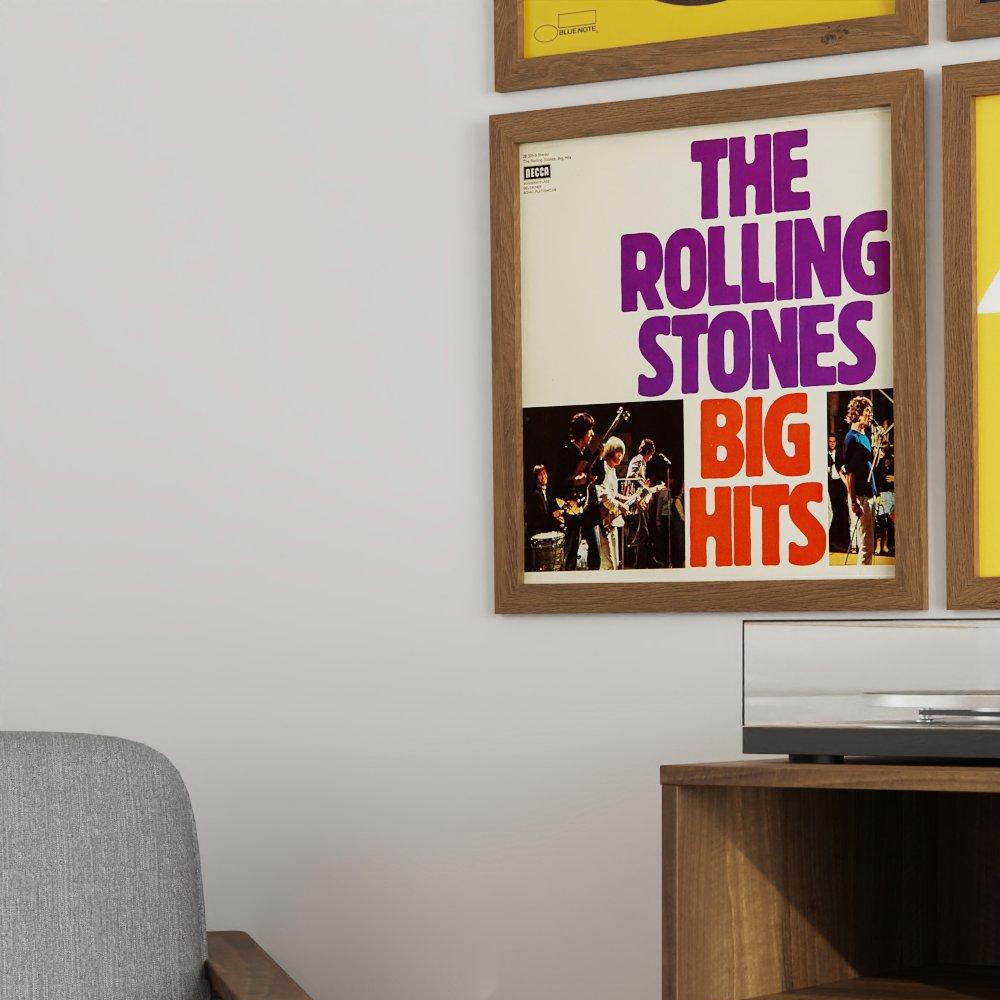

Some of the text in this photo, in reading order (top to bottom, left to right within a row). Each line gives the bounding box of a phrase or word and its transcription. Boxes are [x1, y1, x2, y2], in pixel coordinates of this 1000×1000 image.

[525, 166, 550, 178] DECCA
[691, 129, 810, 219] THE
[620, 210, 891, 312] ROLLING
[638, 300, 876, 398] STONES
[700, 393, 810, 479] BIG
[689, 482, 827, 567] HITS
